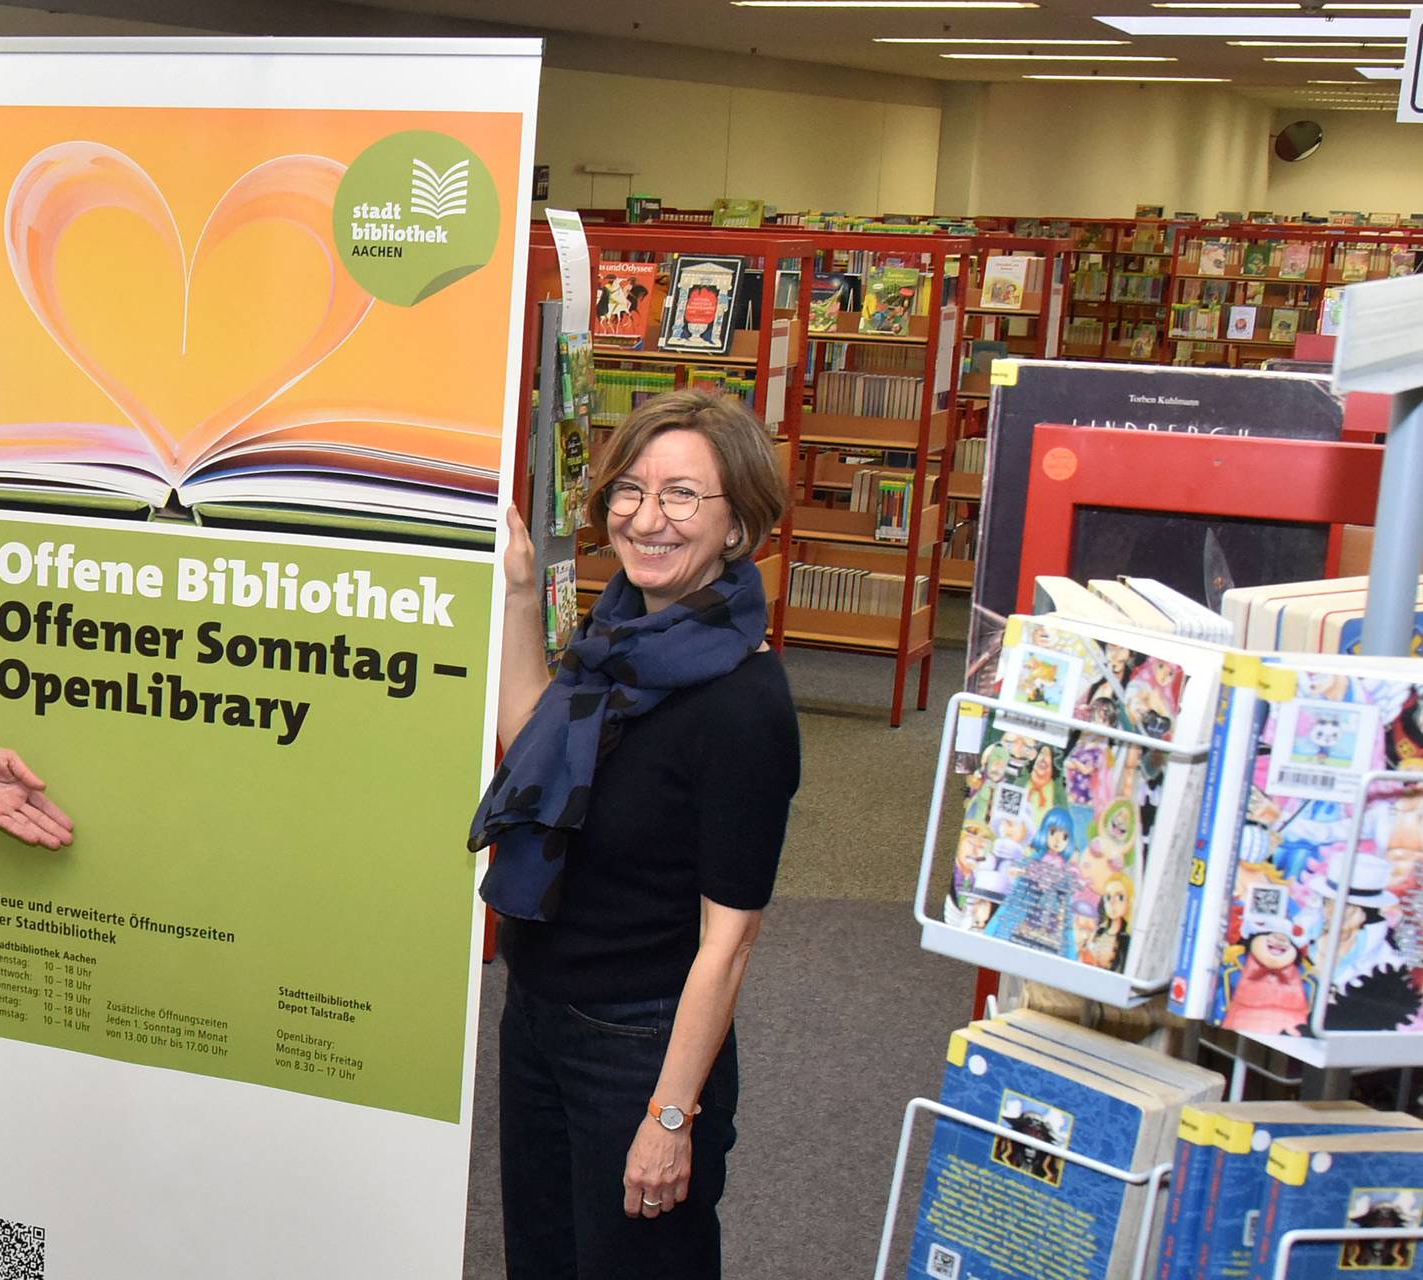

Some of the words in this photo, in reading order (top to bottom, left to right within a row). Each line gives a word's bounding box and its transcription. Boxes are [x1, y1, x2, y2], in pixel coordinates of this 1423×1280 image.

[353, 202, 401, 219] stadt
[351, 223, 448, 243] bibliothek
[352, 245, 402, 258] AACHEN
[622, 263, 654, 273] Odyssee
[1129, 394, 1156, 404] Torben
[178, 557, 456, 628] Bibliothek
[197, 621, 419, 699] Sonntag
[16, 915, 117, 944] Stadtbibliothek
[28, 900, 52, 914] und
[57, 905, 125, 927] erweiterte
[129, 913, 235, 943] Öffnungszeiten
[63, 951, 97, 965] Aachen
[44, 961, 54, 971] 10
[65, 965, 74, 975] 18
[76, 967, 92, 978] Uhr
[44, 975, 54, 984] 10
[65, 979, 74, 988] 18
[76, 980, 91, 991] Uhr
[44, 989, 53, 998] 12
[65, 992, 73, 1001] 19
[76, 994, 91, 1005] Uhr
[278, 986, 372, 1011] Stadtteilbibliothek
[44, 1002, 53, 1011] 10
[64, 1006, 73, 1015] 18
[75, 1007, 90, 1019] Uhr
[106, 1000, 155, 1018] Zusätzliche
[158, 1008, 228, 1029] Öffnungszeiten
[278, 1000, 308, 1014] Depot
[311, 1006, 356, 1023] Talstraße
[43, 1015, 52, 1025] 10
[64, 1019, 72, 1028] 14
[75, 1020, 90, 1032] Uhr
[106, 1014, 131, 1027] Jeden
[134, 1020, 140, 1028] 1.
[143, 1021, 181, 1037] Sonntag
[184, 1027, 195, 1037] im
[198, 1029, 227, 1043] Monat
[106, 1029, 121, 1039] von
[124, 1031, 147, 1044] 13.00
[150, 1035, 167, 1046] Uhr
[170, 1038, 183, 1049] bis
[186, 1041, 209, 1053] 17.00
[211, 1045, 228, 1057] Uhr
[276, 1029, 335, 1050] OpenLibrary:
[276, 1042, 311, 1060] Montag
[314, 1050, 327, 1062] bis
[330, 1053, 363, 1071] Freitag
[275, 1058, 292, 1068] von
[294, 1060, 315, 1073] 8.30
[327, 1066, 336, 1077] 17
[339, 1069, 356, 1080] Uhr
